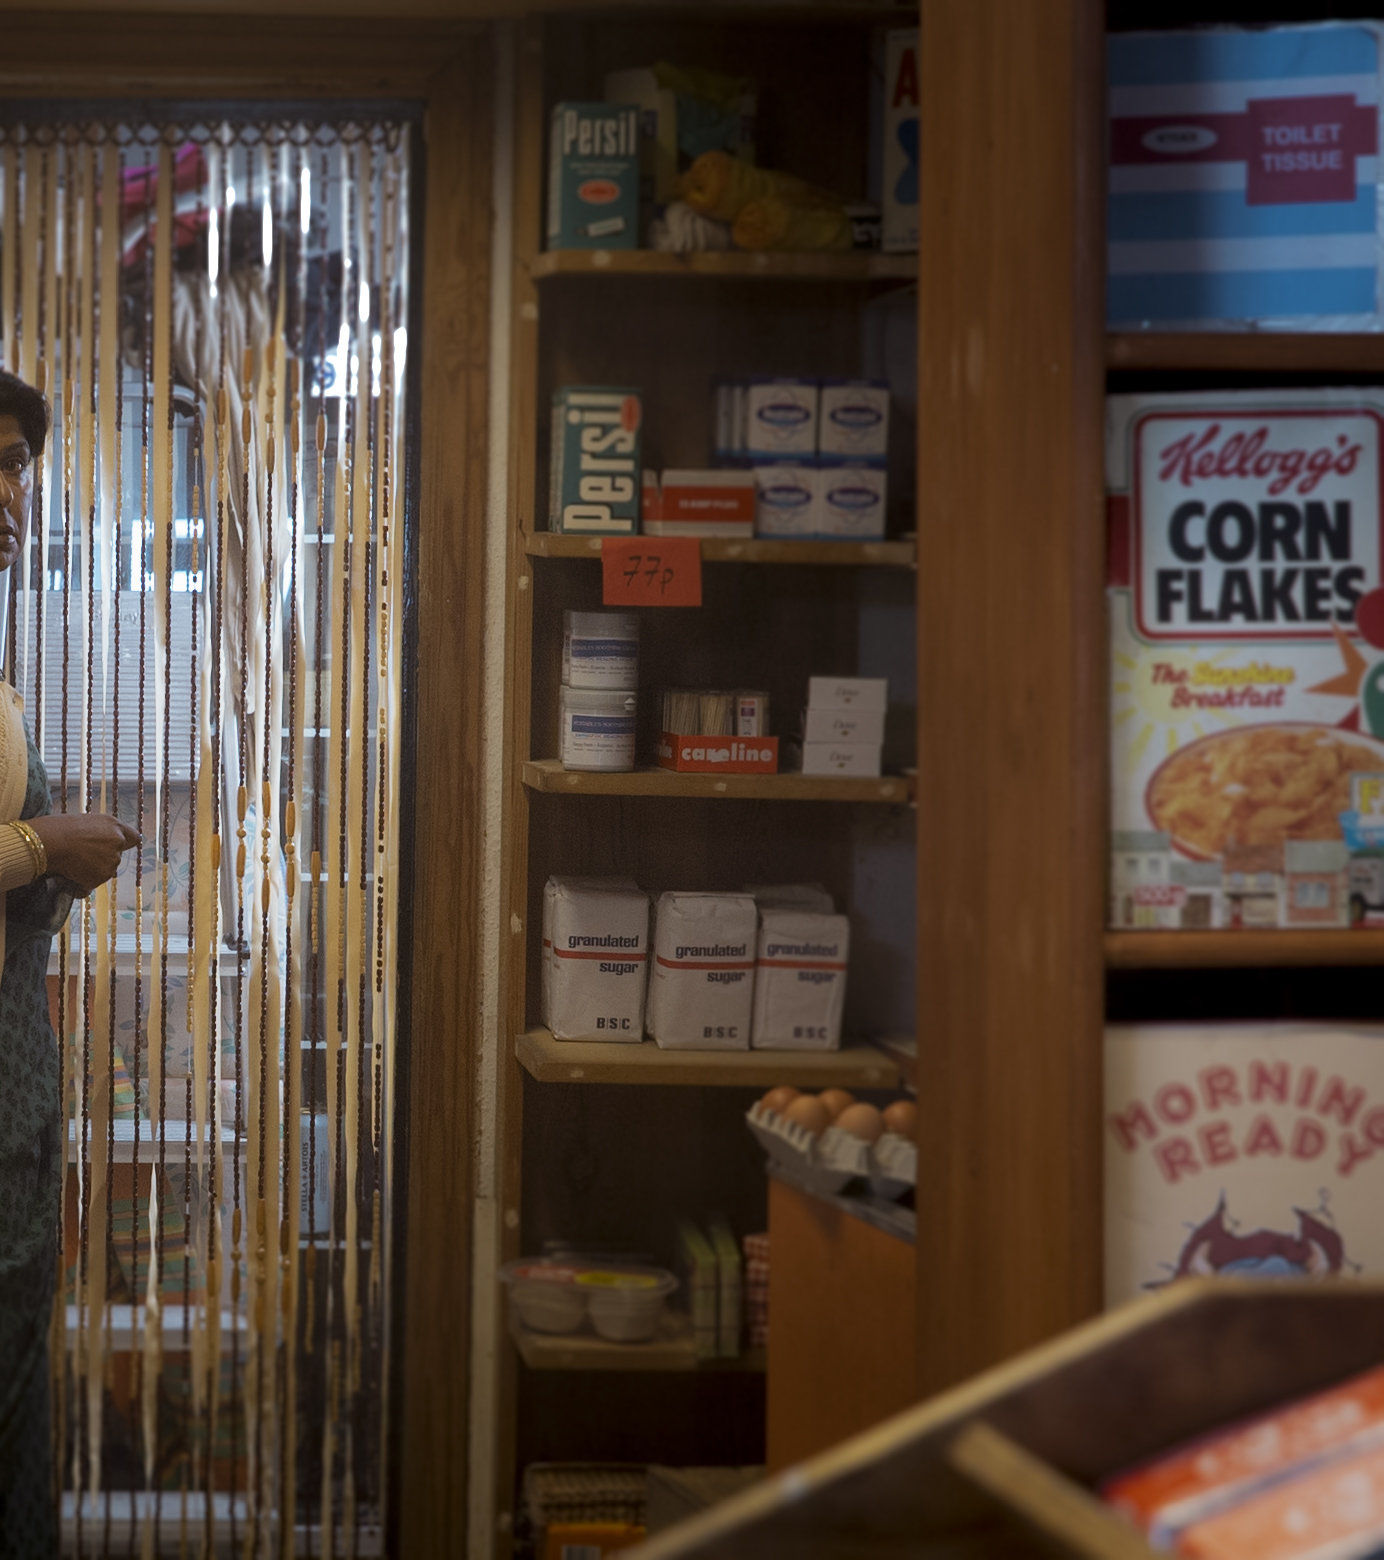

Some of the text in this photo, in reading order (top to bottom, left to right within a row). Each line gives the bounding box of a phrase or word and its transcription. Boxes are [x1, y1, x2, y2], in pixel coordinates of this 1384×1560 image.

[563, 109, 636, 156] Persil
[1262, 123, 1343, 146] TOILET
[1261, 150, 1343, 172] TISSUE
[563, 393, 637, 531] Persil
[1159, 422, 1364, 498] Kellogg's
[1168, 499, 1352, 564] CORN
[1156, 566, 1366, 624] FLAKES
[1151, 661, 1296, 686] The Sunshine
[1170, 685, 1286, 710] Breakfast
[568, 935, 639, 950] granulated
[675, 944, 746, 959] granulated
[767, 943, 838, 958] granulated
[599, 961, 639, 976] sugar
[707, 971, 746, 985] sugar
[797, 971, 837, 985] sugar
[301, 1142, 309, 1173] ARTOIS
[1152, 1113, 1375, 1186] READY
